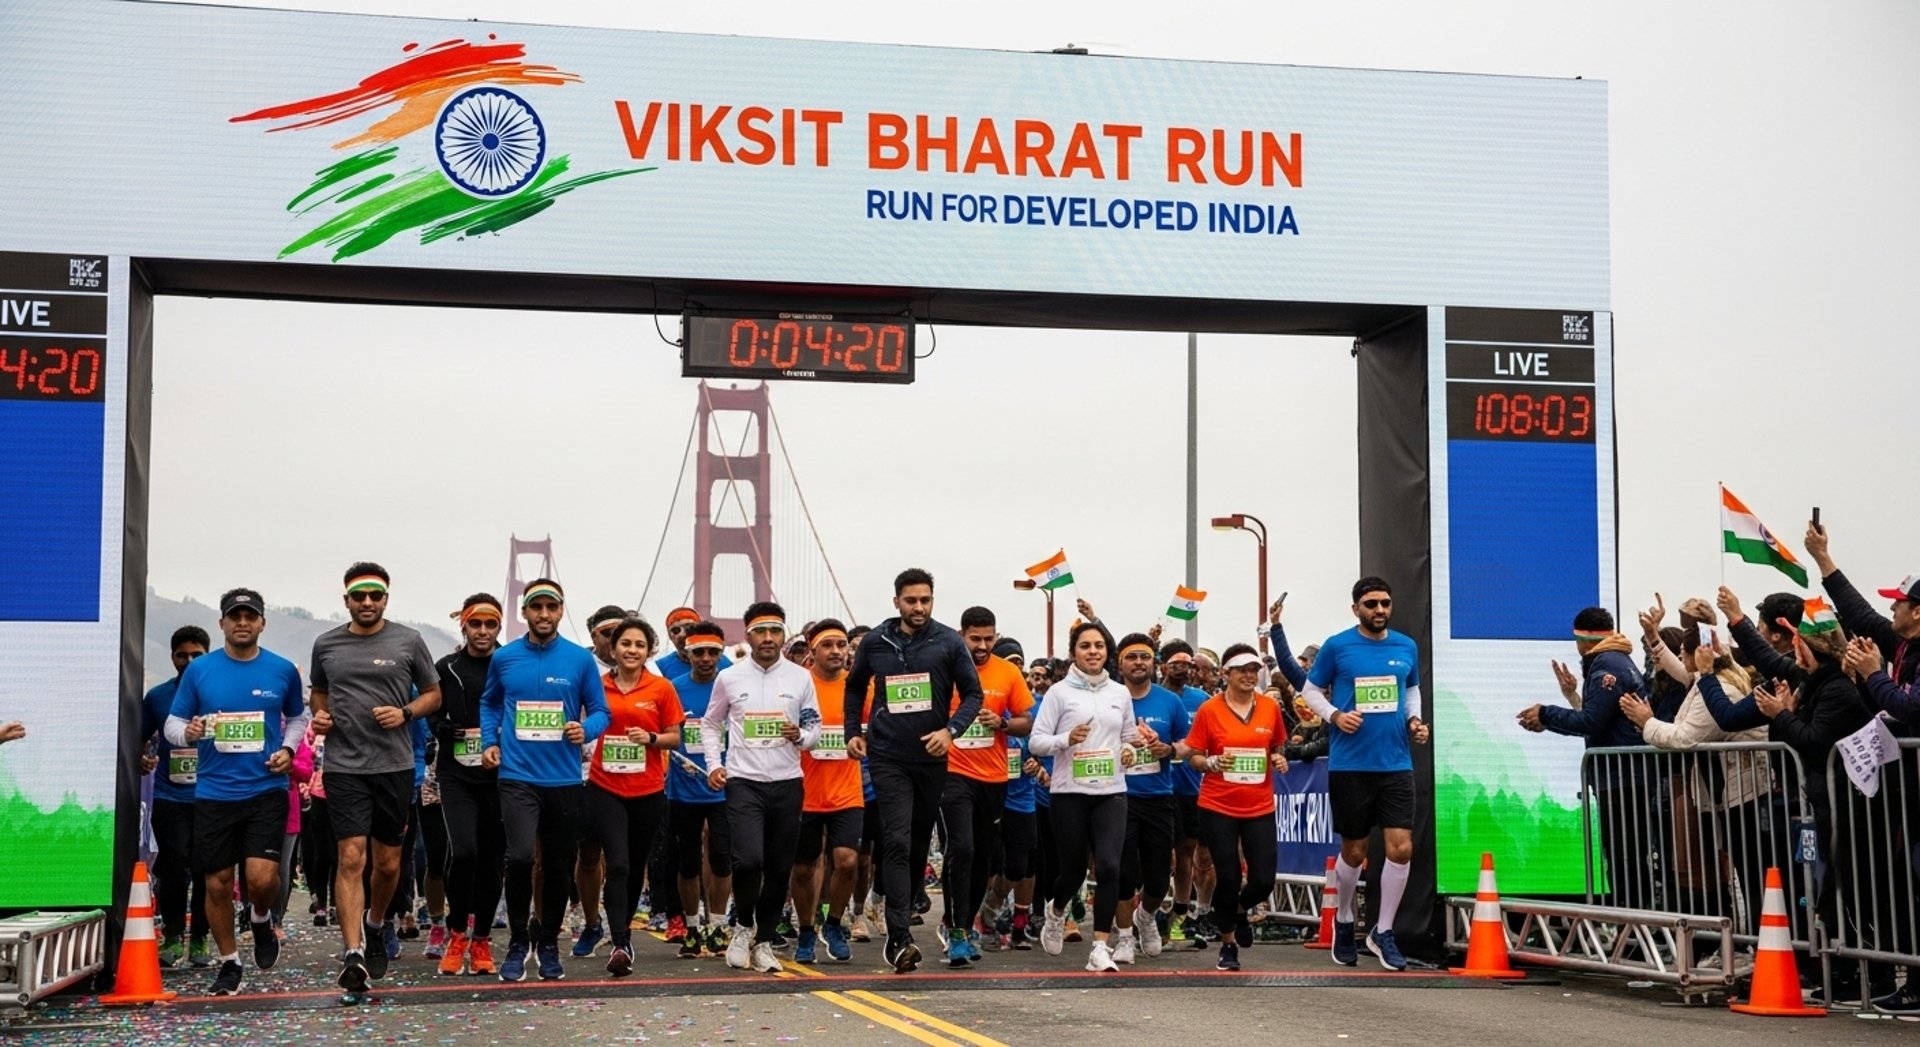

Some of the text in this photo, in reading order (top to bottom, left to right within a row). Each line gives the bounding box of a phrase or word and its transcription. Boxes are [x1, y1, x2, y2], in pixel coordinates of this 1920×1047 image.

[614, 99, 1304, 189] VIKSIT BHARAT RUN
[867, 189, 1299, 236] RUN FOR DEVELOPED INDIA
[0, 299, 50, 327] IVE
[729, 319, 905, 373] 0:04:20
[1494, 351, 1549, 376] LIVE
[1474, 392, 1592, 437] 108:03
